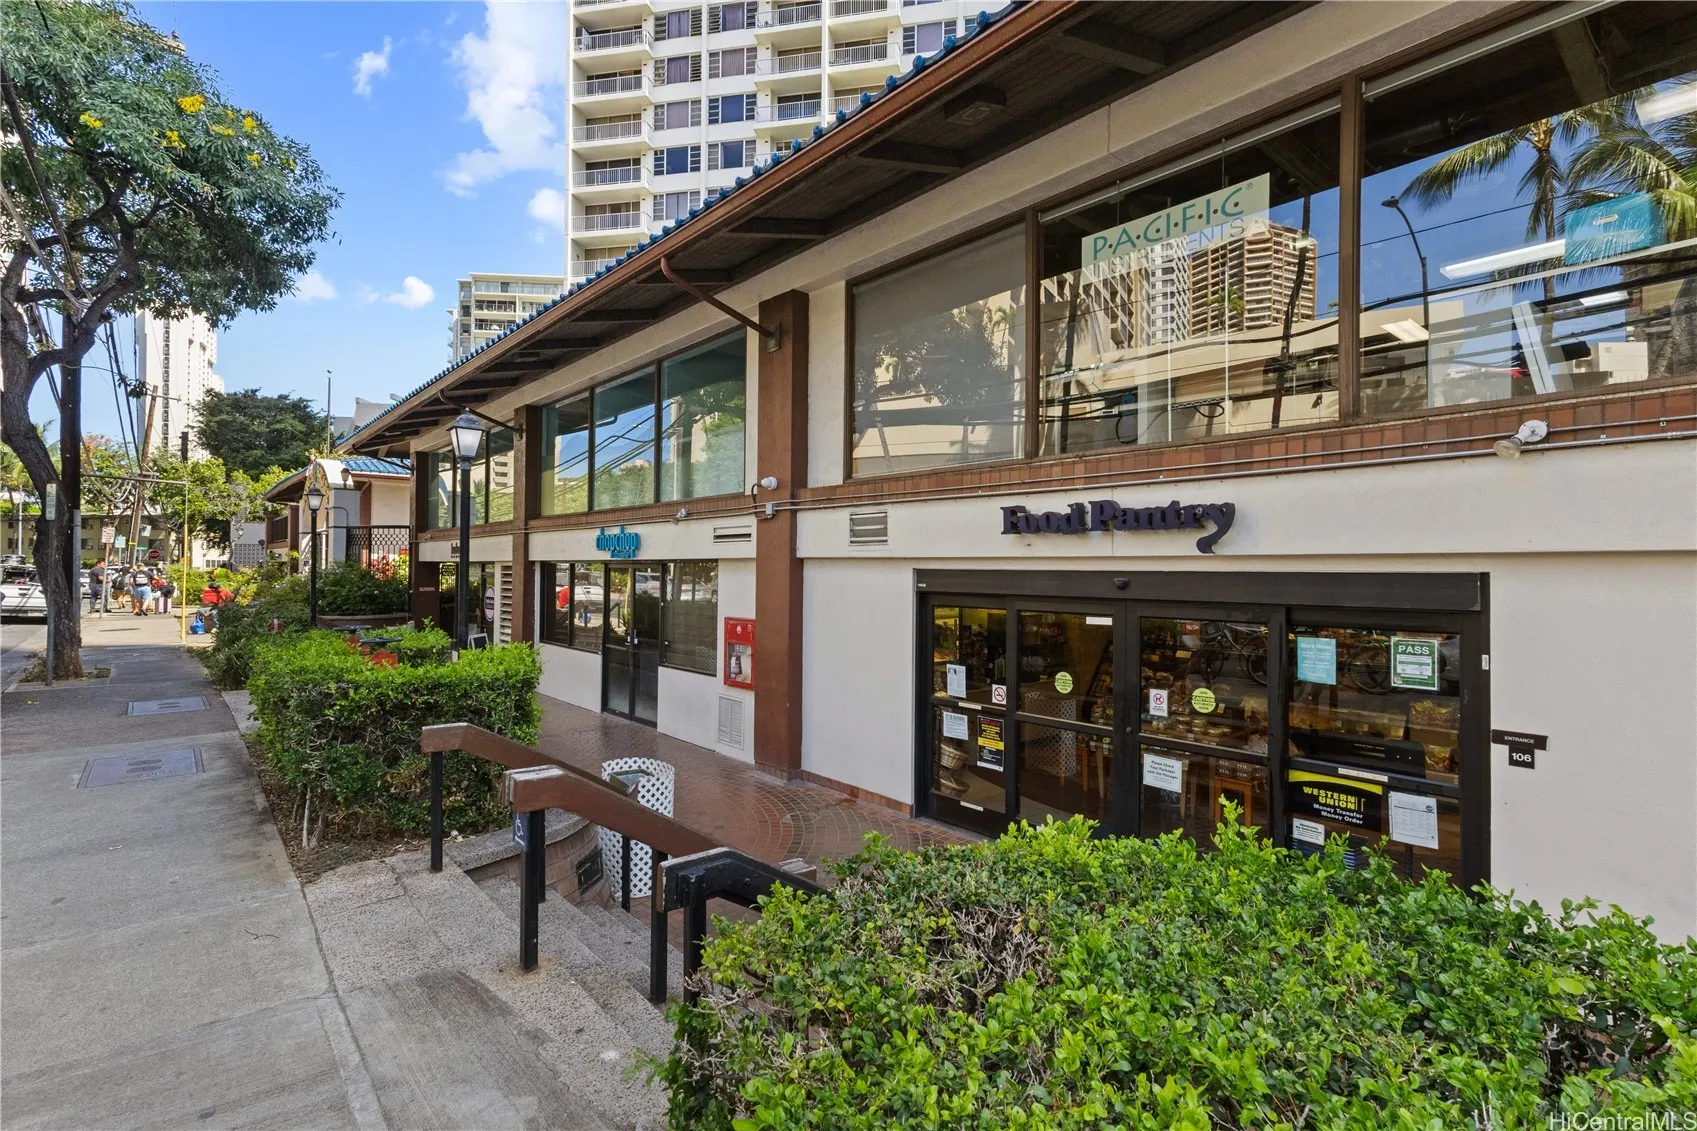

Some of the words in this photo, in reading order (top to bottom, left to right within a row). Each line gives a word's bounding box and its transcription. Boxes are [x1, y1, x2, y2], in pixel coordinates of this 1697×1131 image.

[1399, 645, 1430, 655] PASS
[1504, 736, 1535, 744] ENTRANCE
[1511, 753, 1532, 762] 106
[1303, 786, 1355, 802] WESTERN
[1319, 797, 1355, 810] UNION
[1313, 803, 1335, 813] Money
[1336, 808, 1363, 818] Transfer
[1321, 811, 1342, 820] Money
[1344, 814, 1363, 824] Order
